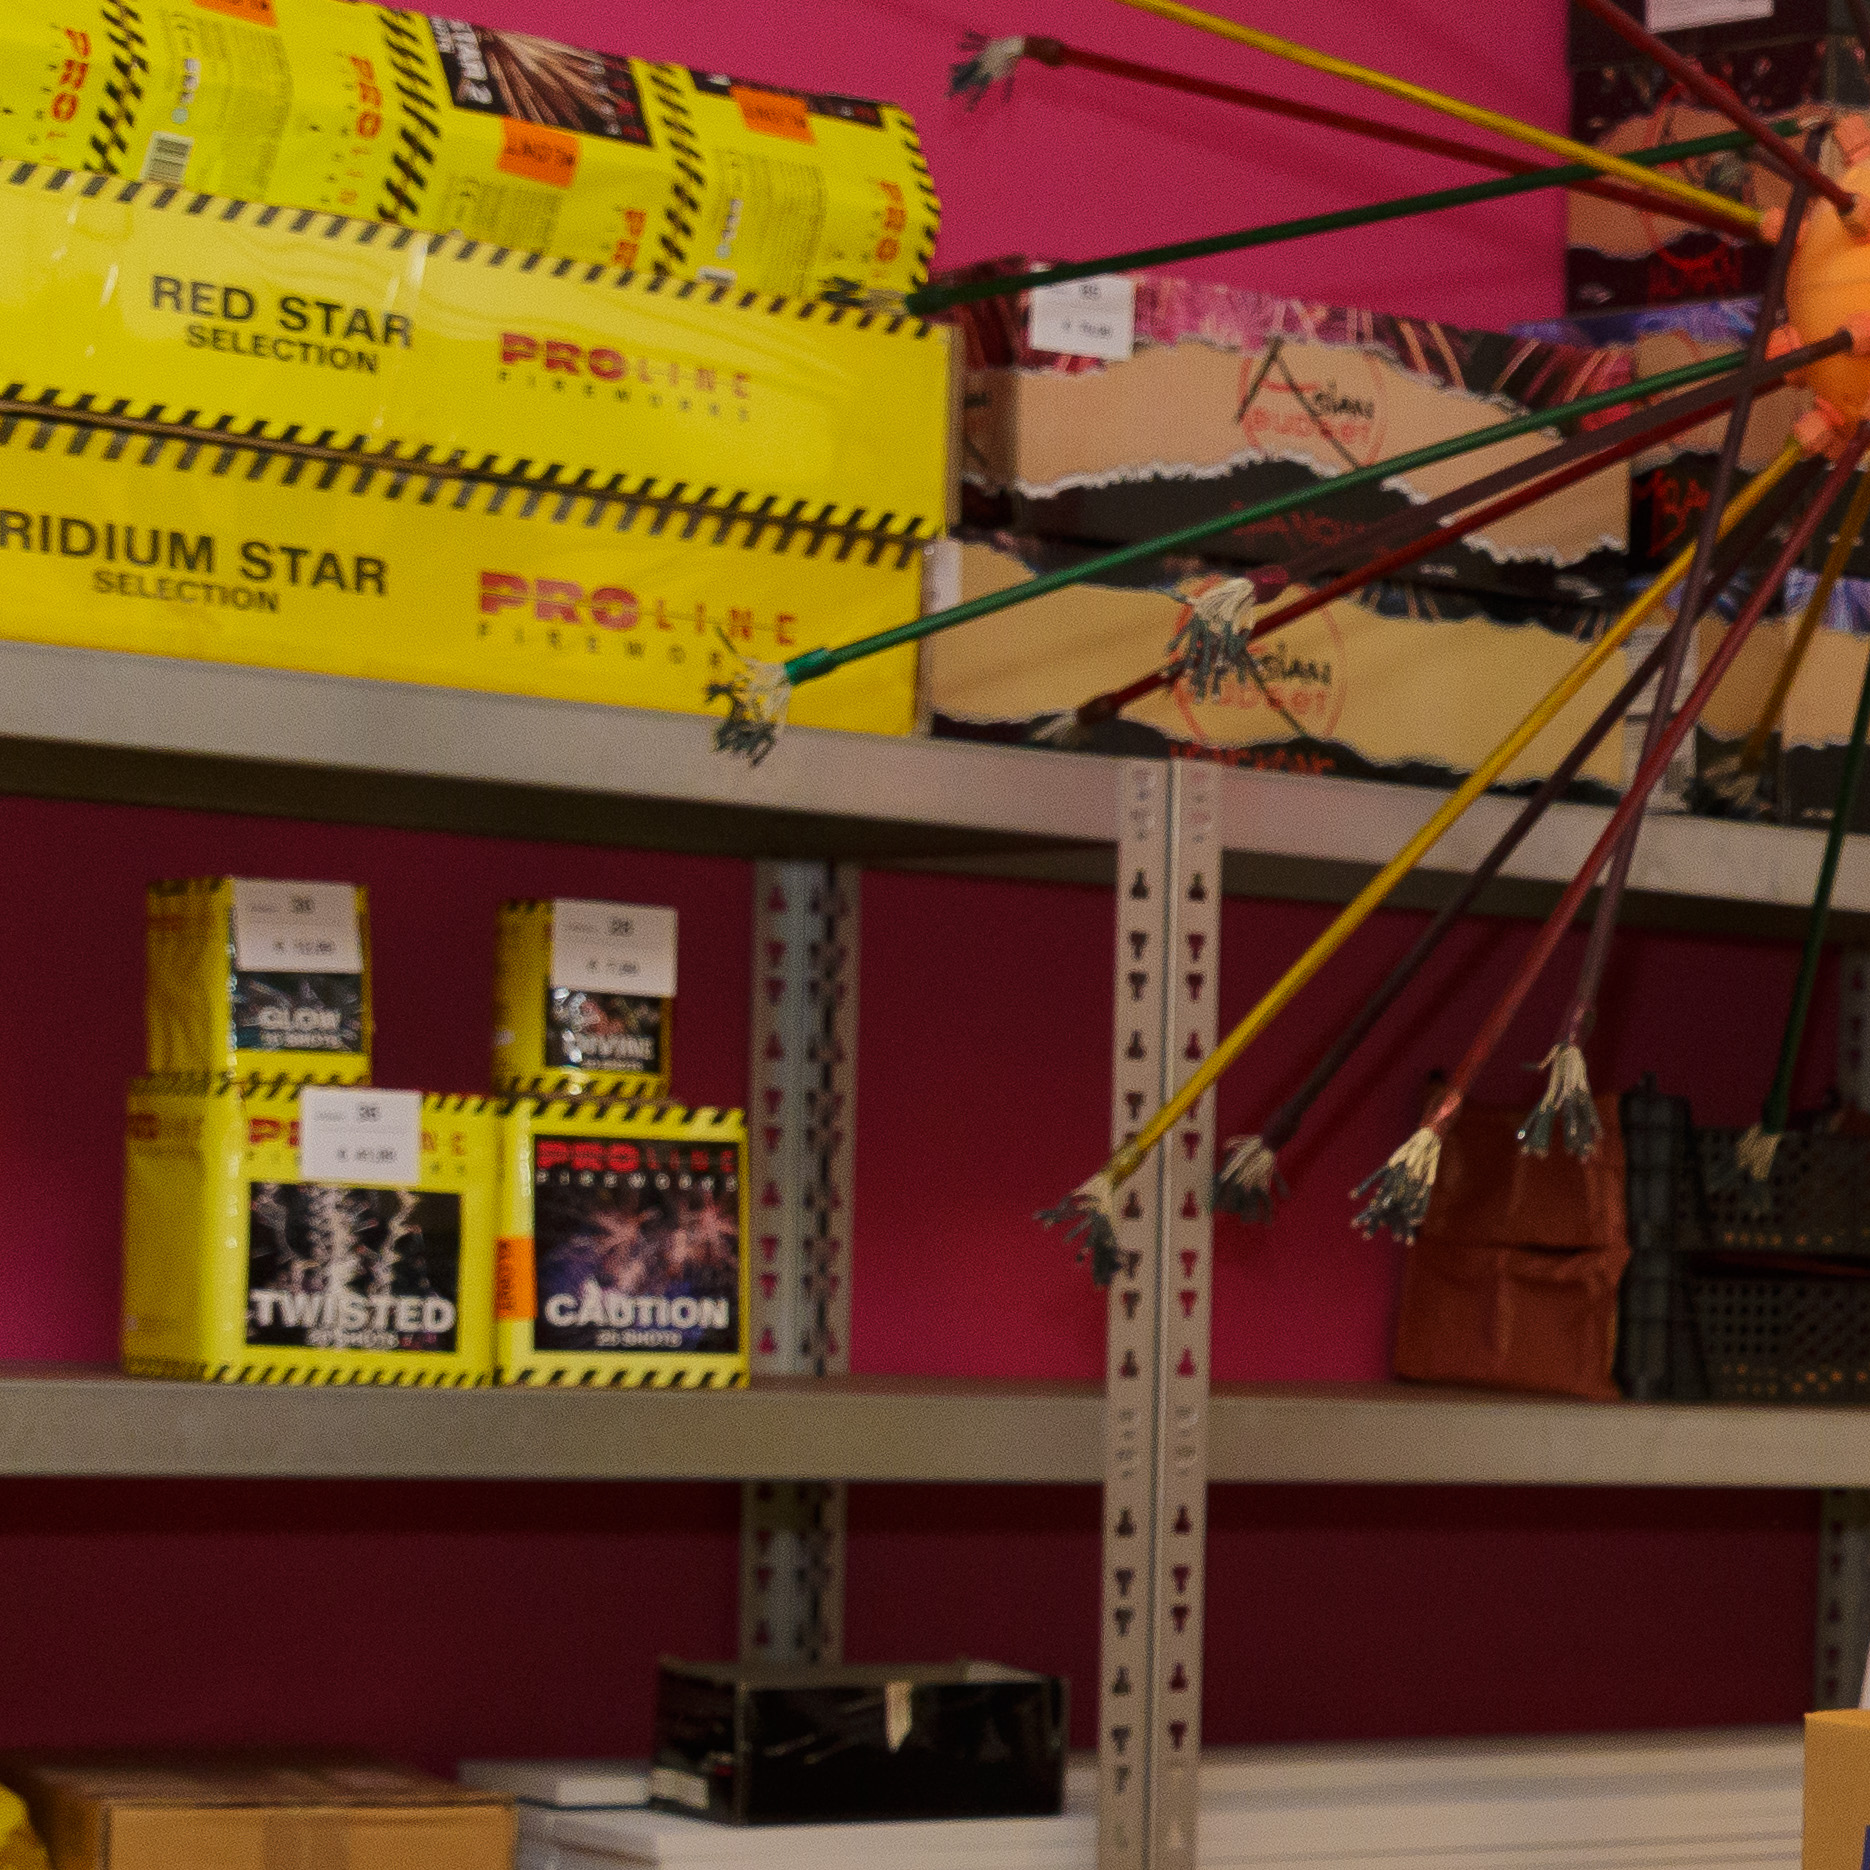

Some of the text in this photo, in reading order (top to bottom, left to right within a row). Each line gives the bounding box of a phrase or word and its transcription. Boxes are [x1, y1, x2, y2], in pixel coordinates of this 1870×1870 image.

[151, 275, 413, 350] RED STAR
[185, 322, 380, 376] SELECTION
[499, 332, 752, 402] PROLINE
[93, 568, 281, 614] SELECTION
[238, 538, 389, 598] STAR
[479, 568, 798, 648] PROLINE
[249, 1288, 457, 1333] TWISTED
[545, 1276, 730, 1329] CAUTION
